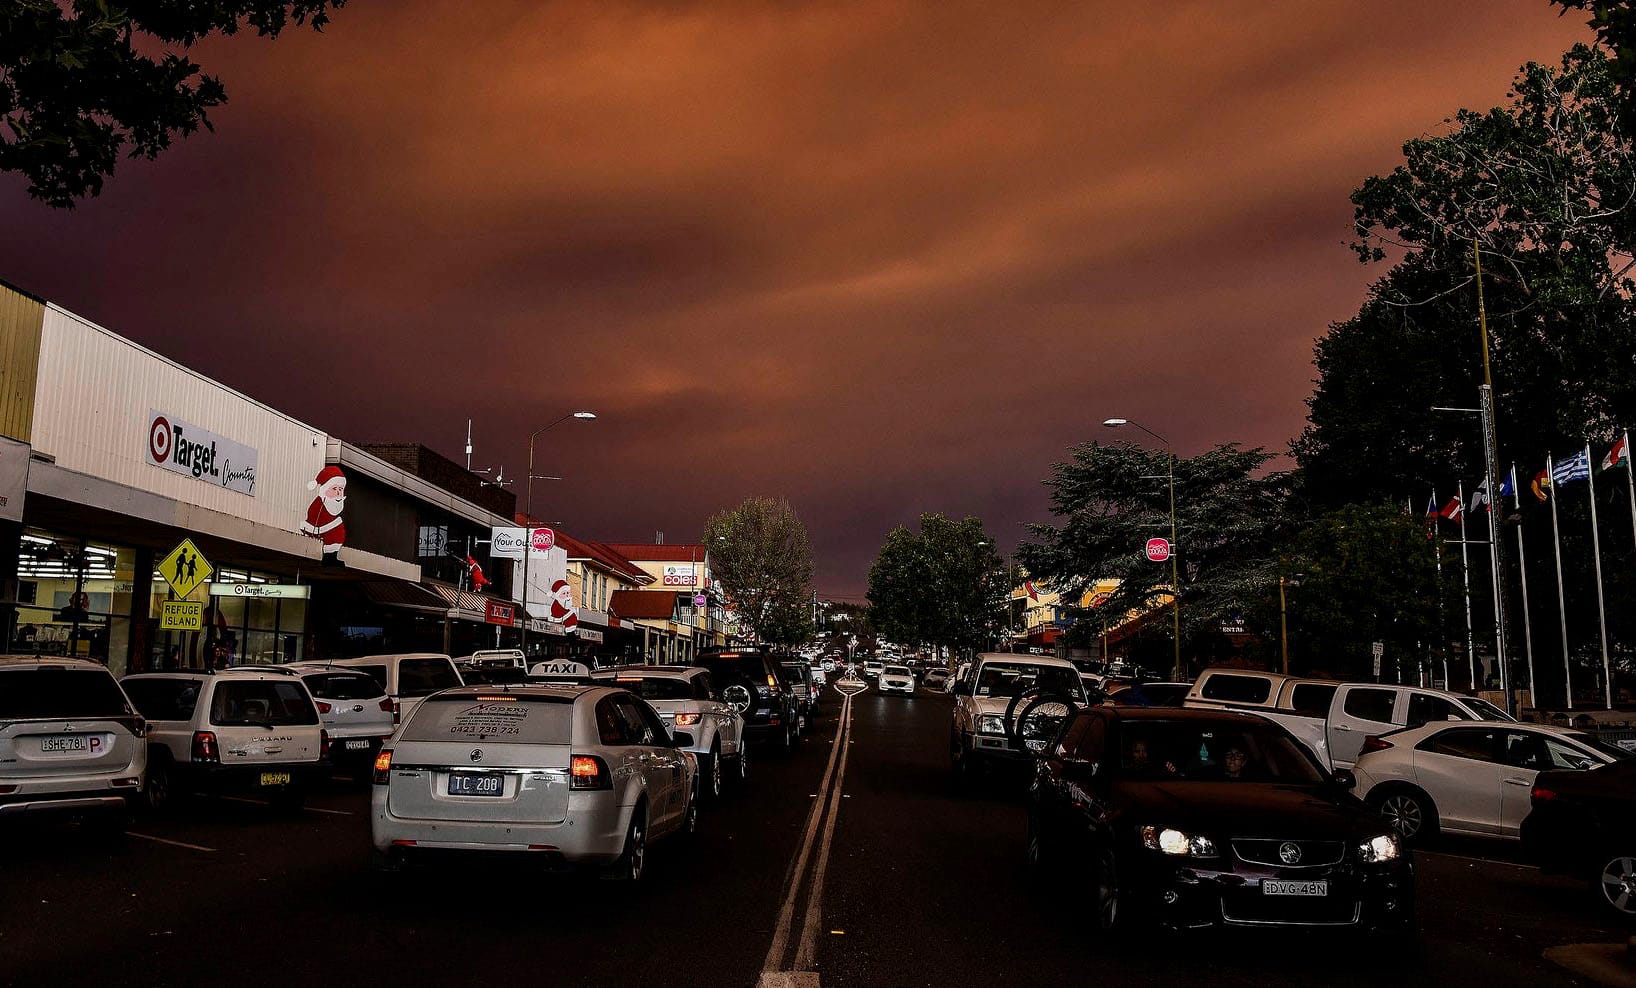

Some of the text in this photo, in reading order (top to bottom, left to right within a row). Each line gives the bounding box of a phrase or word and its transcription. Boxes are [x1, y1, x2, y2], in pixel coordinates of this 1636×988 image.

[222, 458, 256, 493] Country
[496, 538, 514, 546] Your
[664, 576, 697, 585] coles
[165, 605, 199, 615] REFUGE
[165, 616, 198, 627] ISLAND
[542, 663, 577, 673] TAXI
[500, 727, 520, 735] 724
[89, 737, 101, 753] P
[455, 776, 498, 792] TC 208
